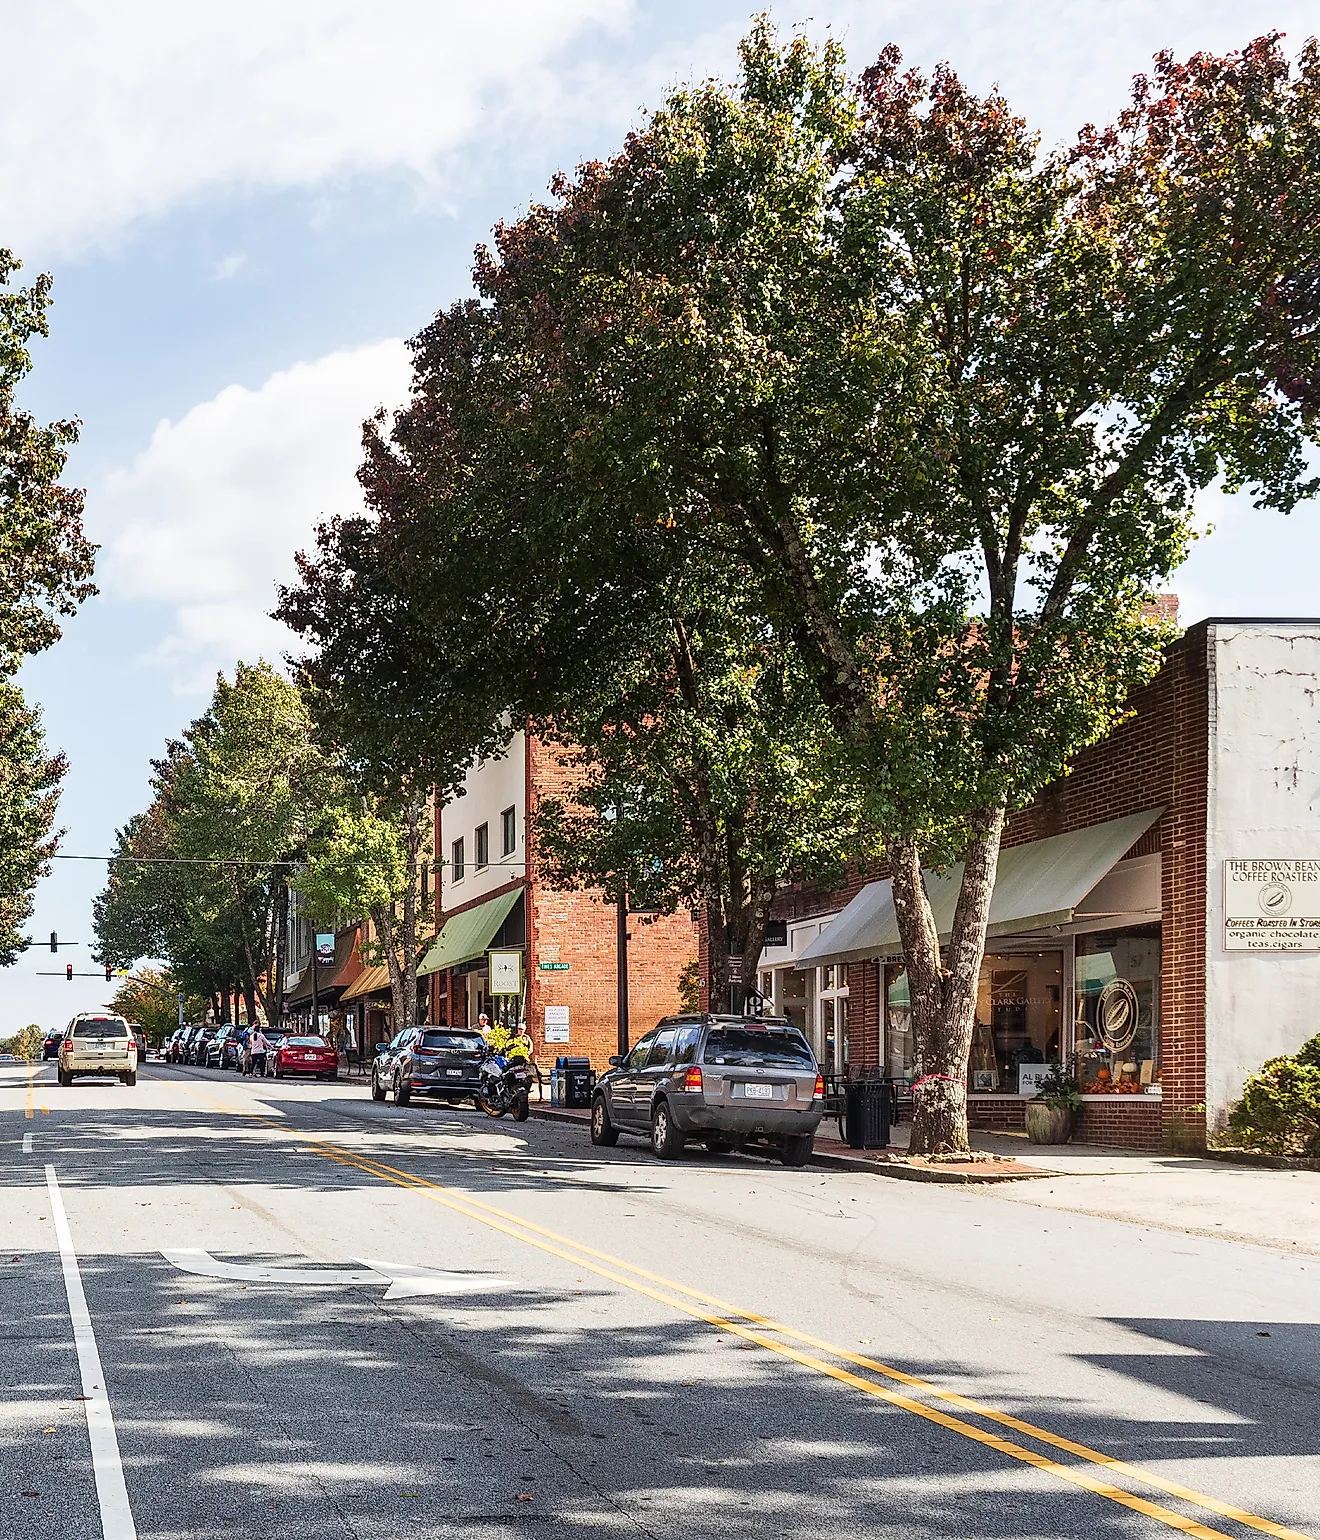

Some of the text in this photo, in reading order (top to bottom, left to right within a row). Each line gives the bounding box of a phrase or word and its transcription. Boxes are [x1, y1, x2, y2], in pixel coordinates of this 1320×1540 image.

[1230, 861, 1248, 871] THE
[1251, 861, 1291, 871] BROWN
[1232, 871, 1318, 881] COFFEE ROASTERS
[1229, 930, 1319, 940] organic chocolate
